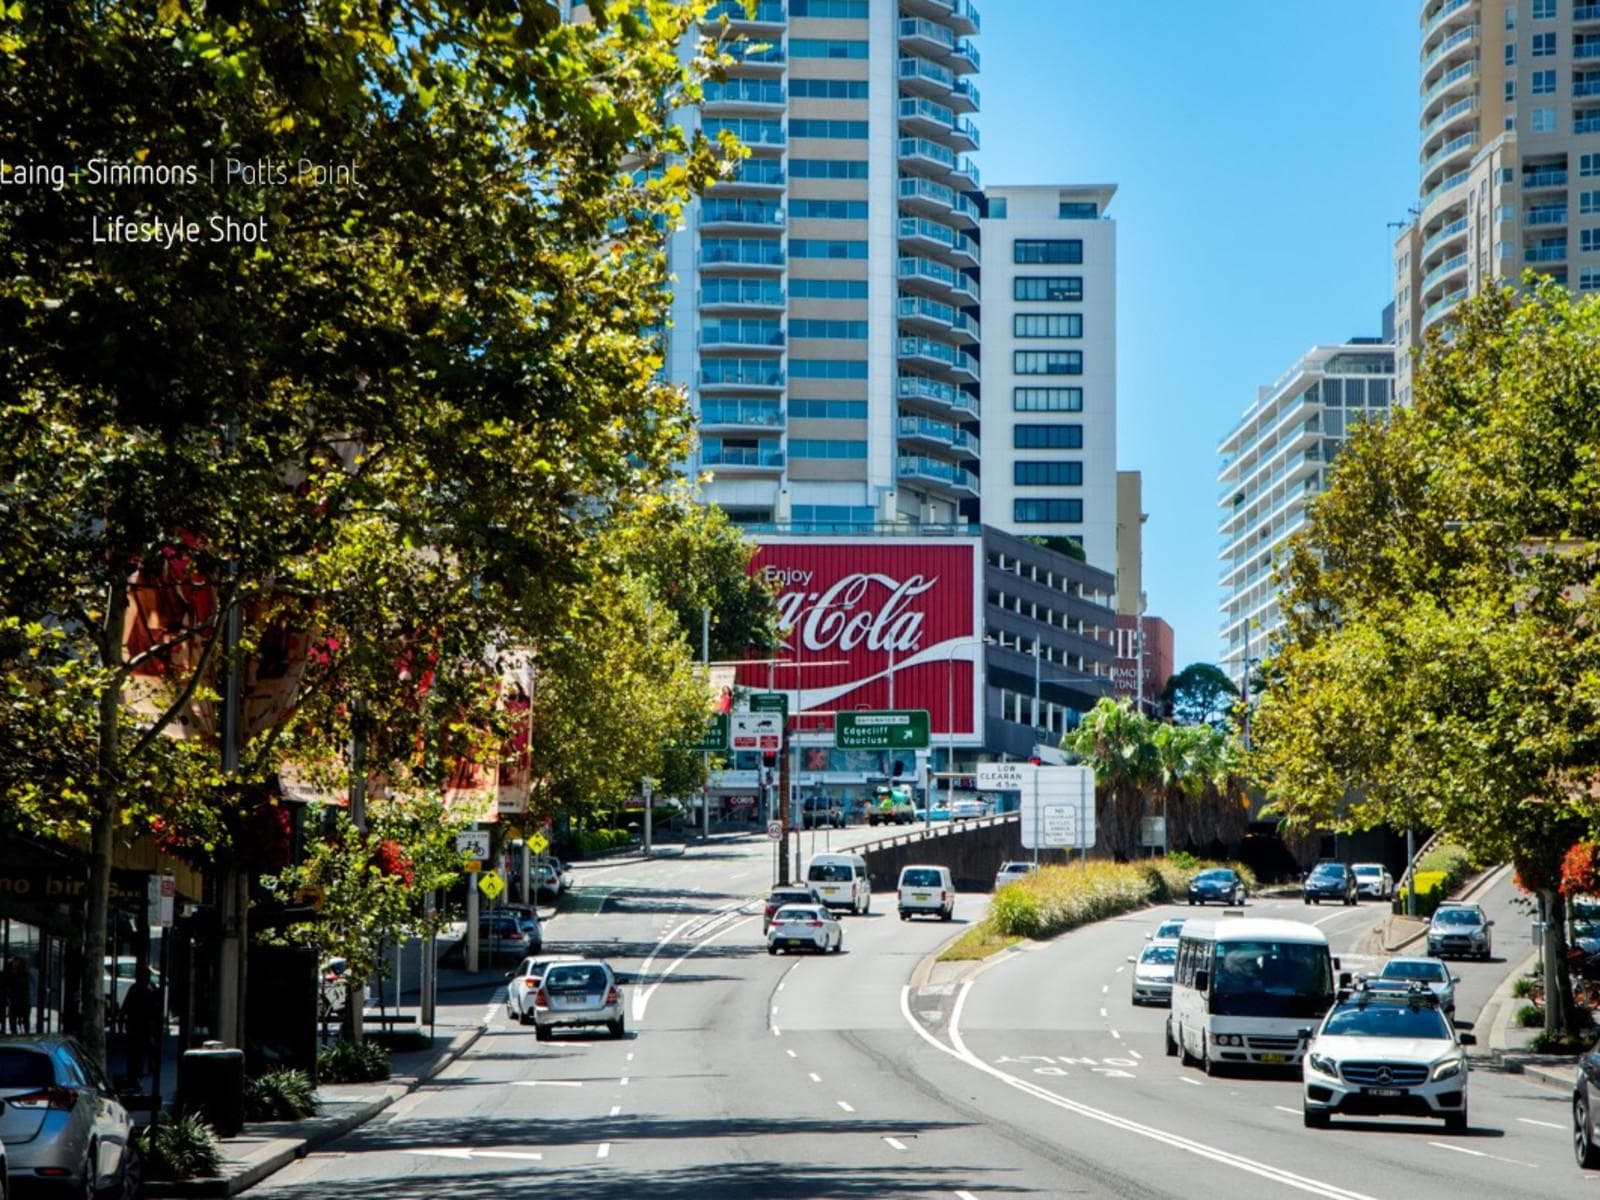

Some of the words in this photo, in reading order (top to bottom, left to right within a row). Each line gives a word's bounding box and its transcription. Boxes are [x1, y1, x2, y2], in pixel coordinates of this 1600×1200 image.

[765, 565, 814, 586] Enjoy
[843, 726, 888, 736] Edgecliff
[843, 737, 888, 745] Vaucluse
